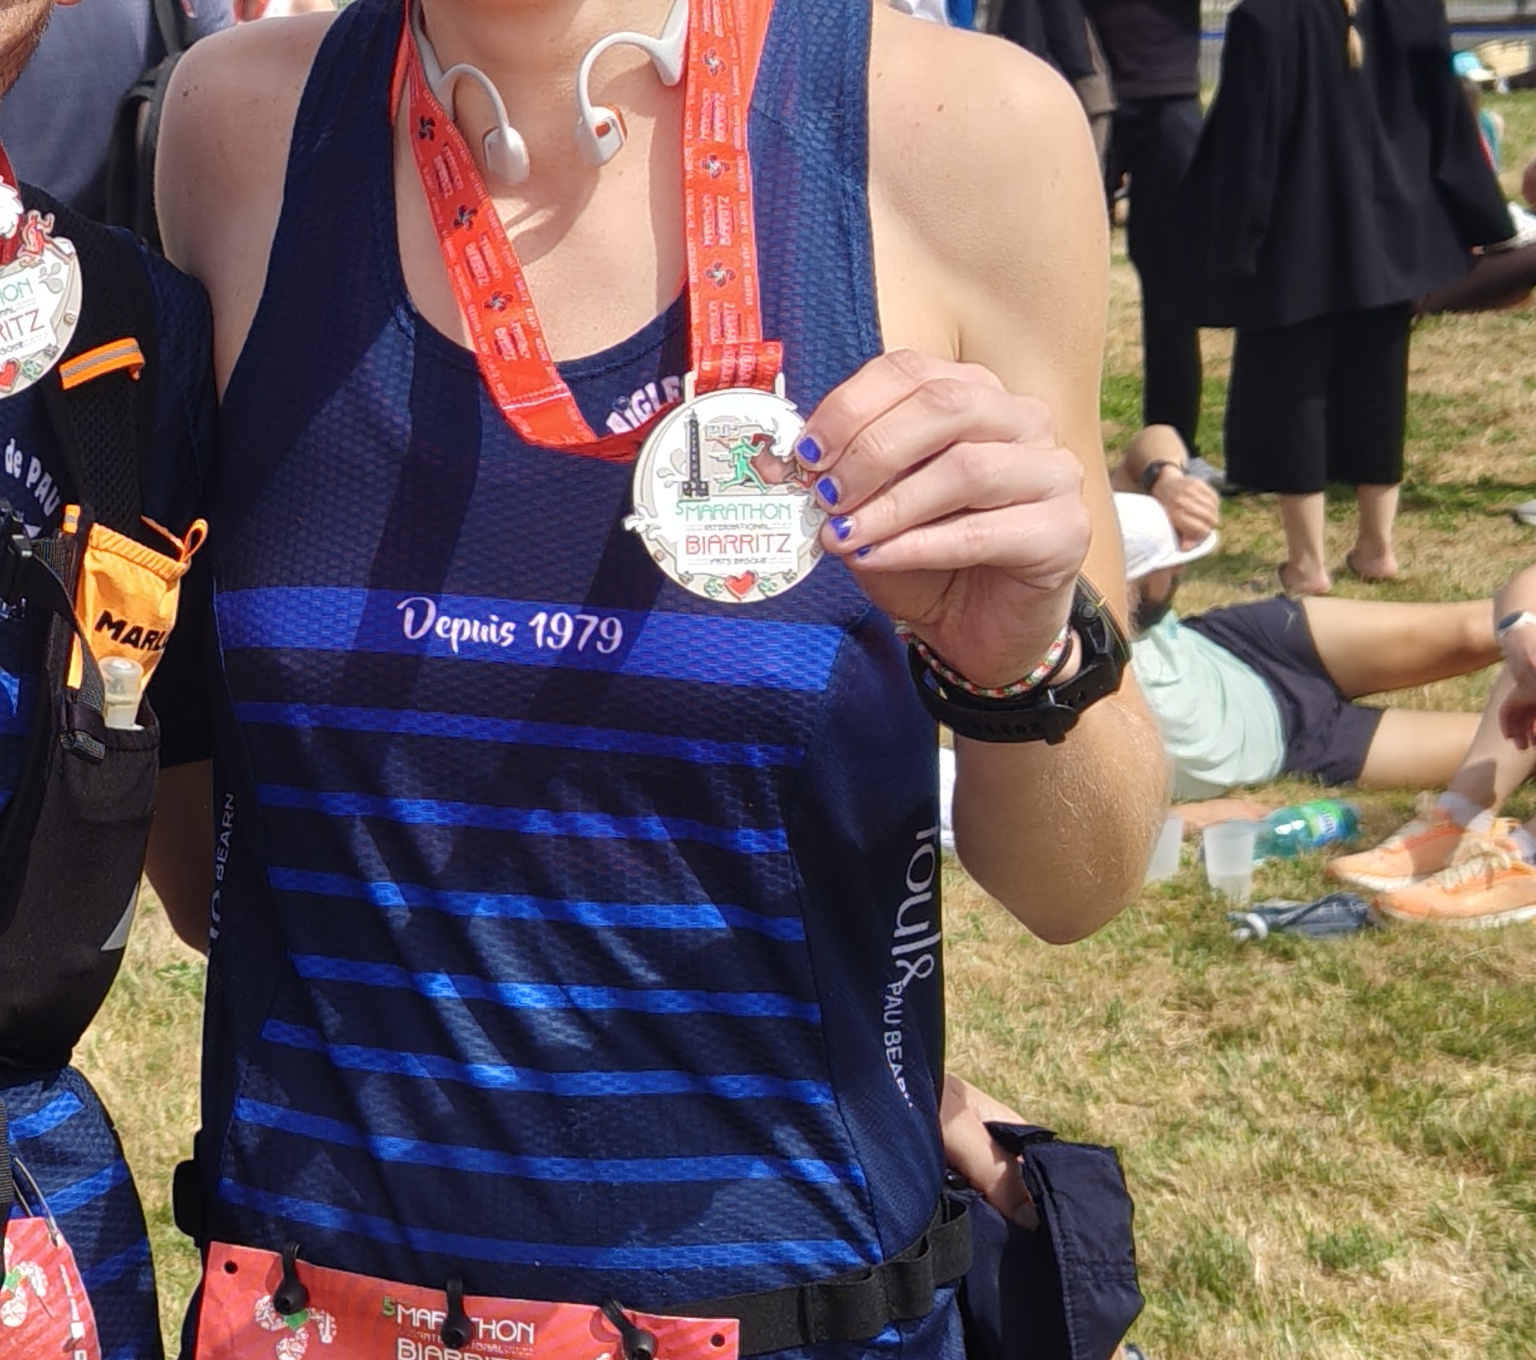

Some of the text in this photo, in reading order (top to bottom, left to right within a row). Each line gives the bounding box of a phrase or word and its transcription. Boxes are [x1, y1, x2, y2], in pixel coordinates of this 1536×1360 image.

[6, 438, 23, 478] de
[26, 455, 62, 516] PAU
[685, 503, 791, 521] MARATHON
[686, 534, 791, 555] BIARRITZ
[397, 596, 623, 655] Depuis 1979
[882, 981, 904, 1025] PAU
